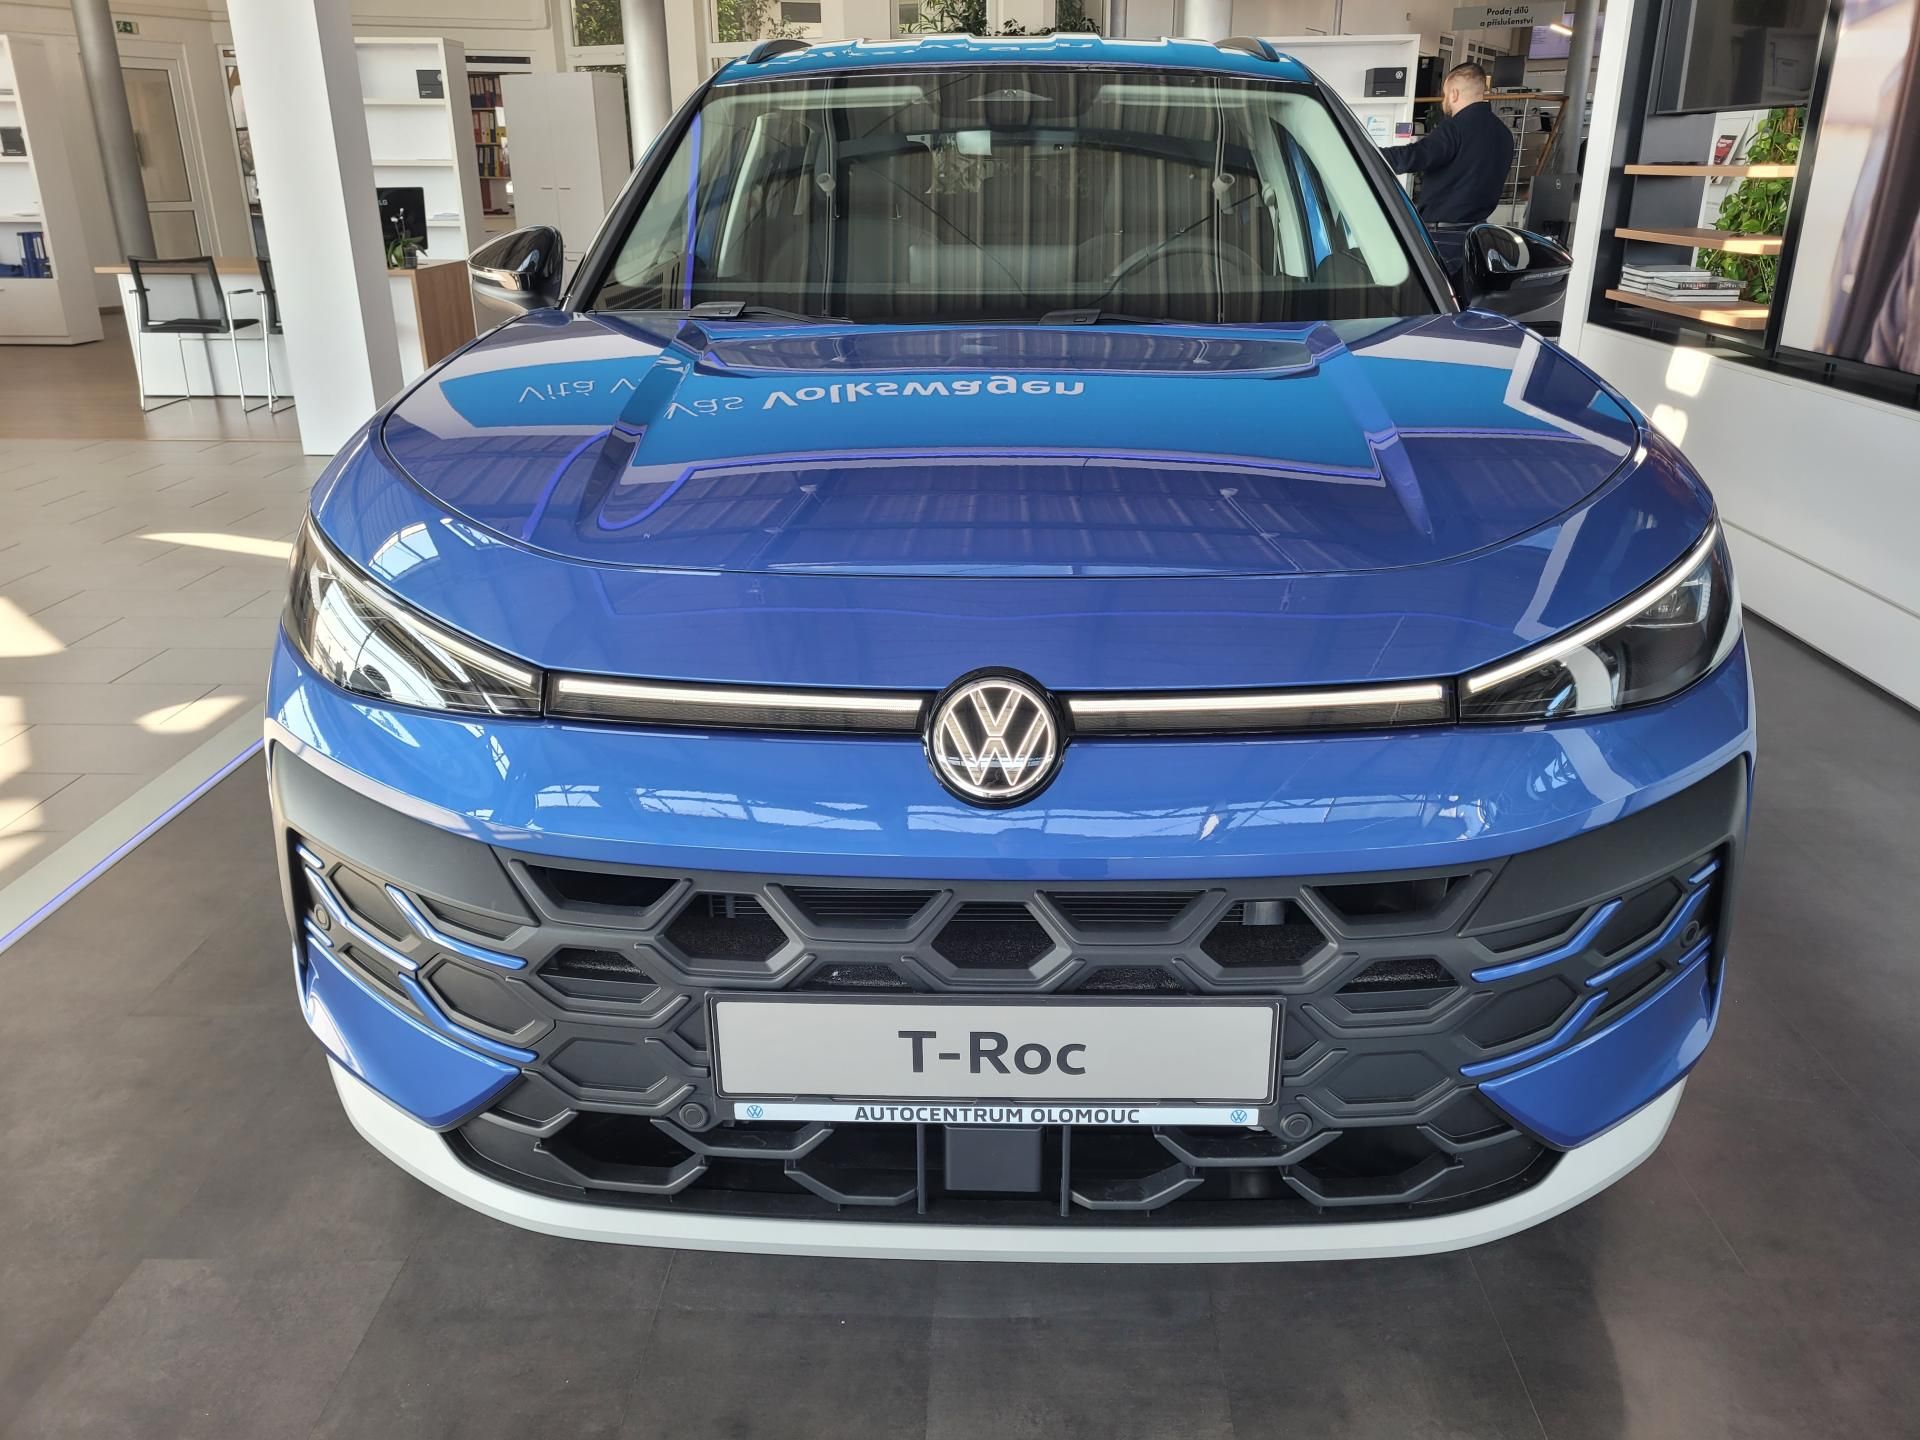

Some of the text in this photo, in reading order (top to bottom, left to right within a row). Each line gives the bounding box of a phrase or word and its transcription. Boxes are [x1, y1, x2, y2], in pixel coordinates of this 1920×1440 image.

[1486, 7, 1512, 16] Prodej
[898, 1031, 1087, 1075] T-Roc
[855, 1106, 1023, 1123] AUTOCENTRUM
[1031, 1108, 1140, 1124] OLOMOUC
